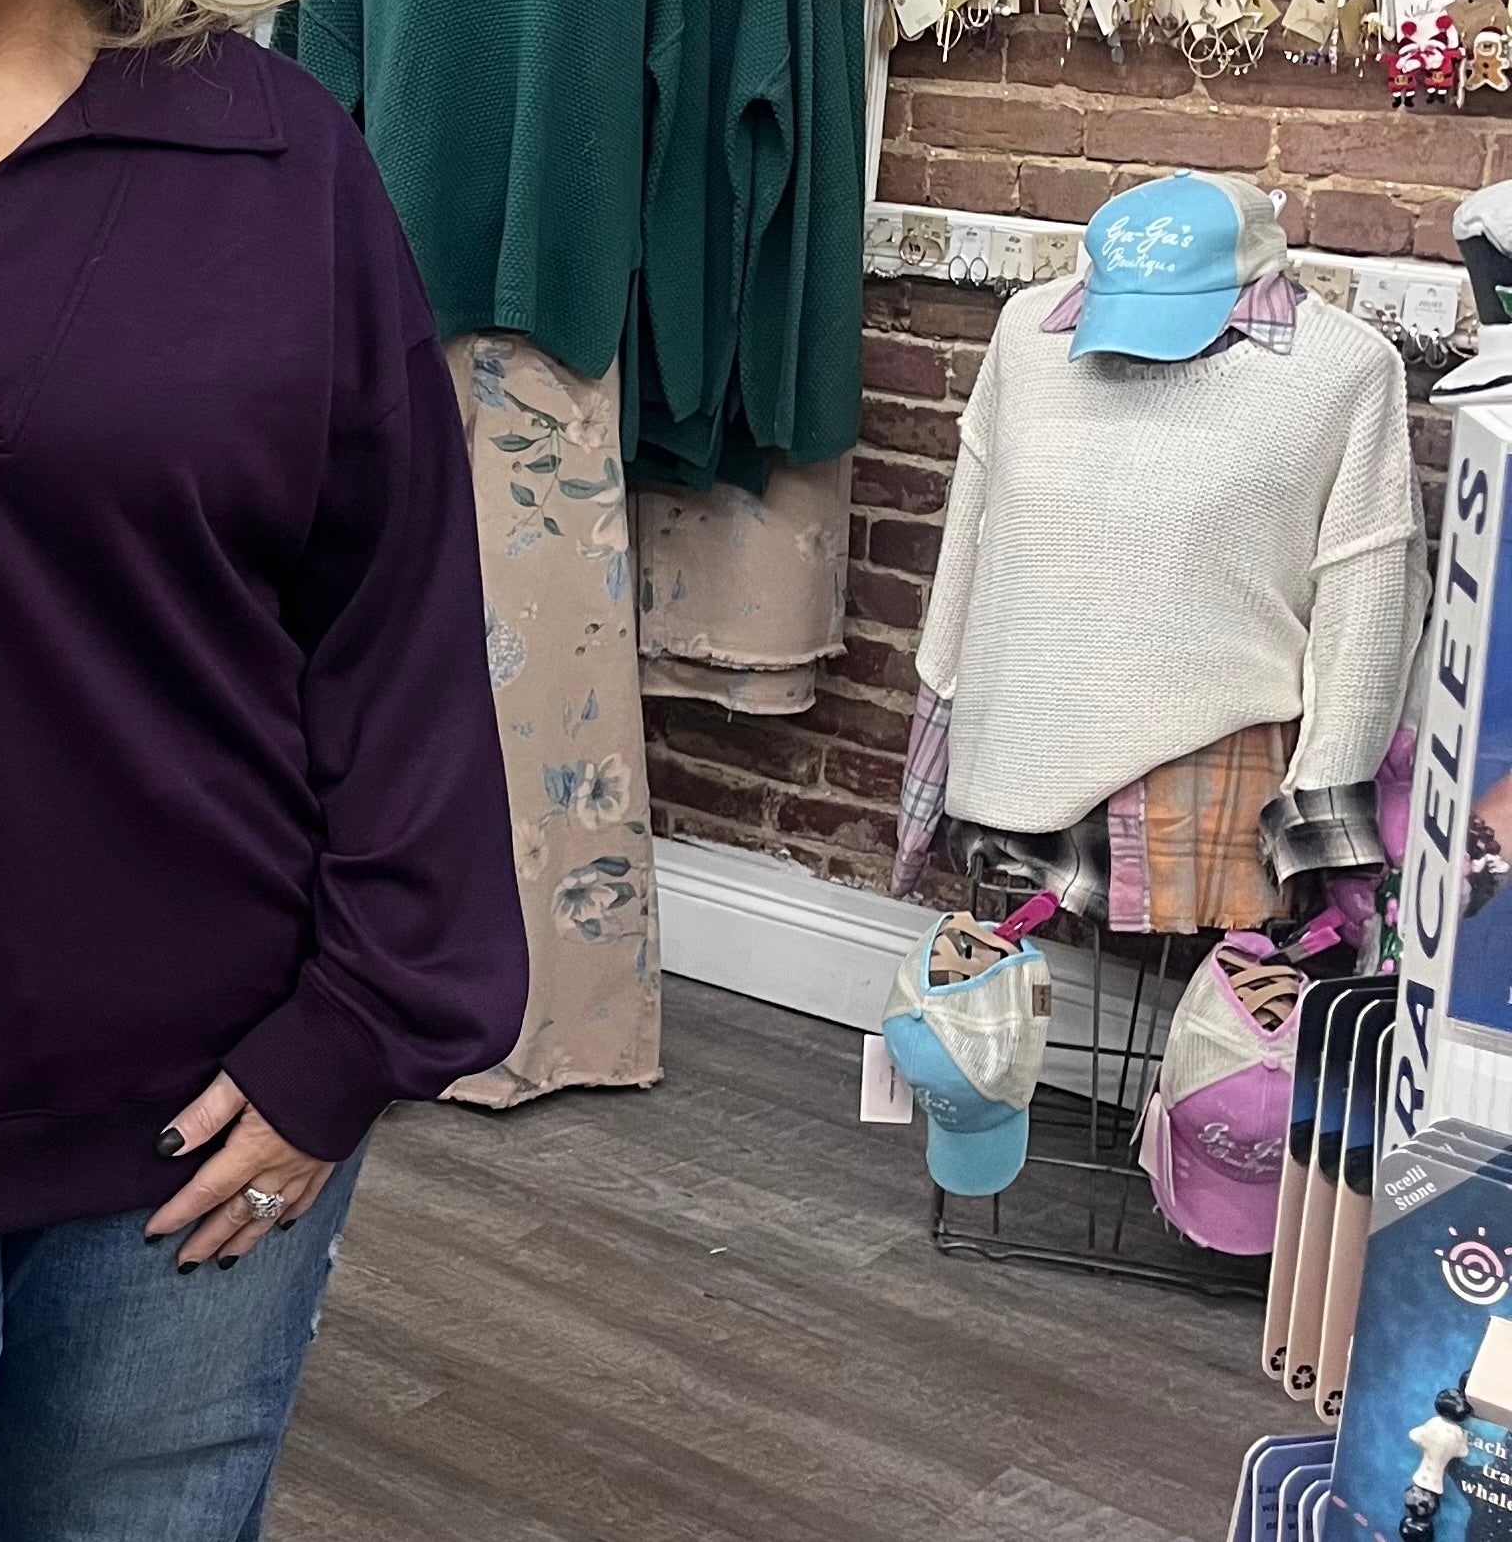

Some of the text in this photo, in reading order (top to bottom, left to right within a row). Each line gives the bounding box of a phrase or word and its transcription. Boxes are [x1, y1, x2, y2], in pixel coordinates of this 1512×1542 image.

[1391, 456, 1489, 1150] RACELETS
[1384, 1163, 1428, 1197] Ocelli
[1394, 1181, 1437, 1212] Stone
